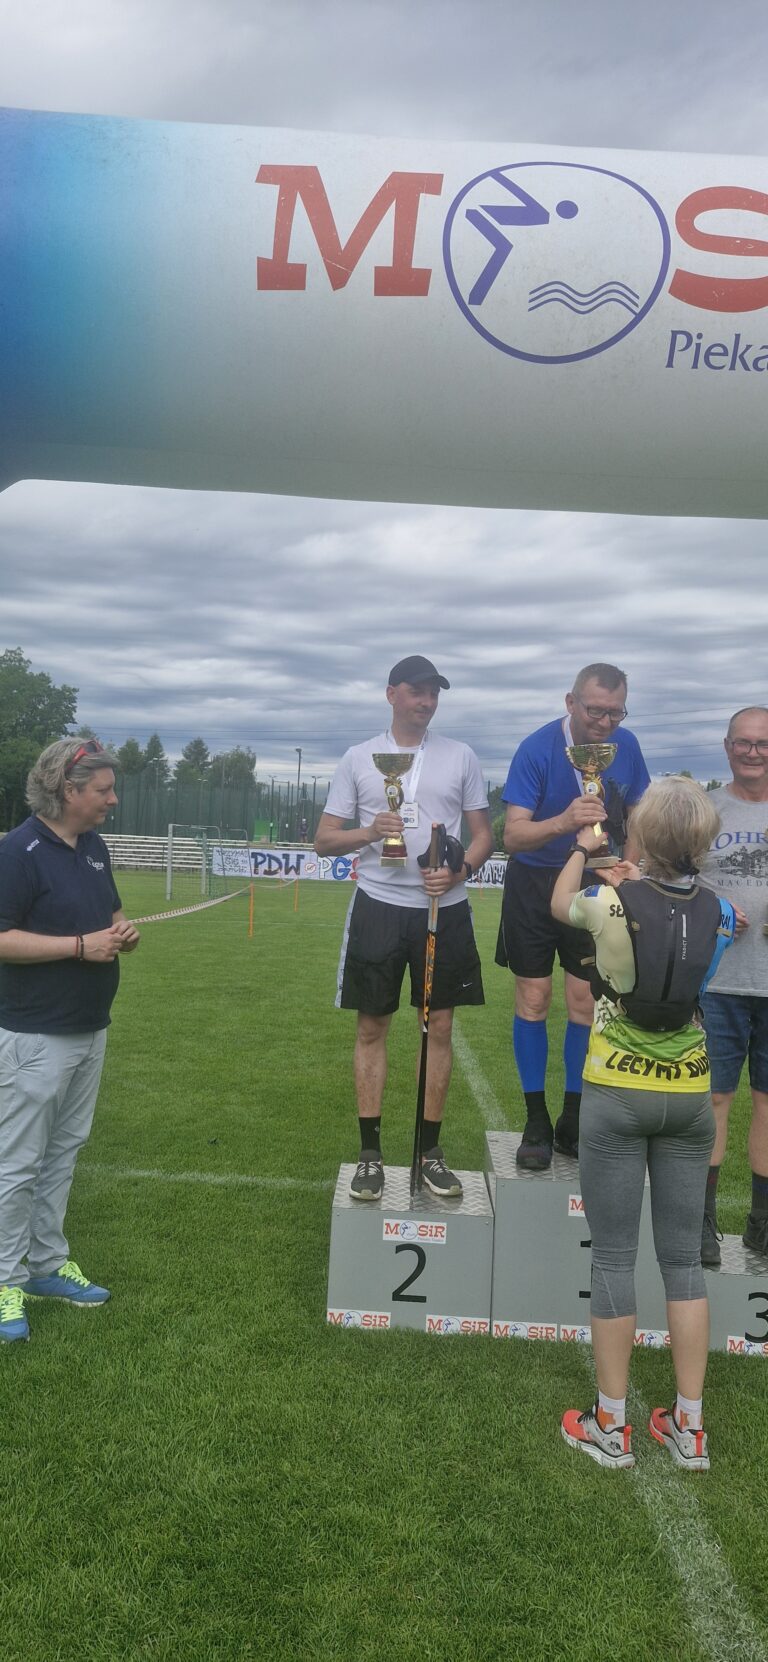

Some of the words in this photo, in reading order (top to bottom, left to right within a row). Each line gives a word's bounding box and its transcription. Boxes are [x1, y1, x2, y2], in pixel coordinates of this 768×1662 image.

[666, 330, 768, 372] Pieka
[251, 852, 305, 875] PDW
[392, 1243, 427, 1303] 2
[745, 1292, 768, 1343] 3
